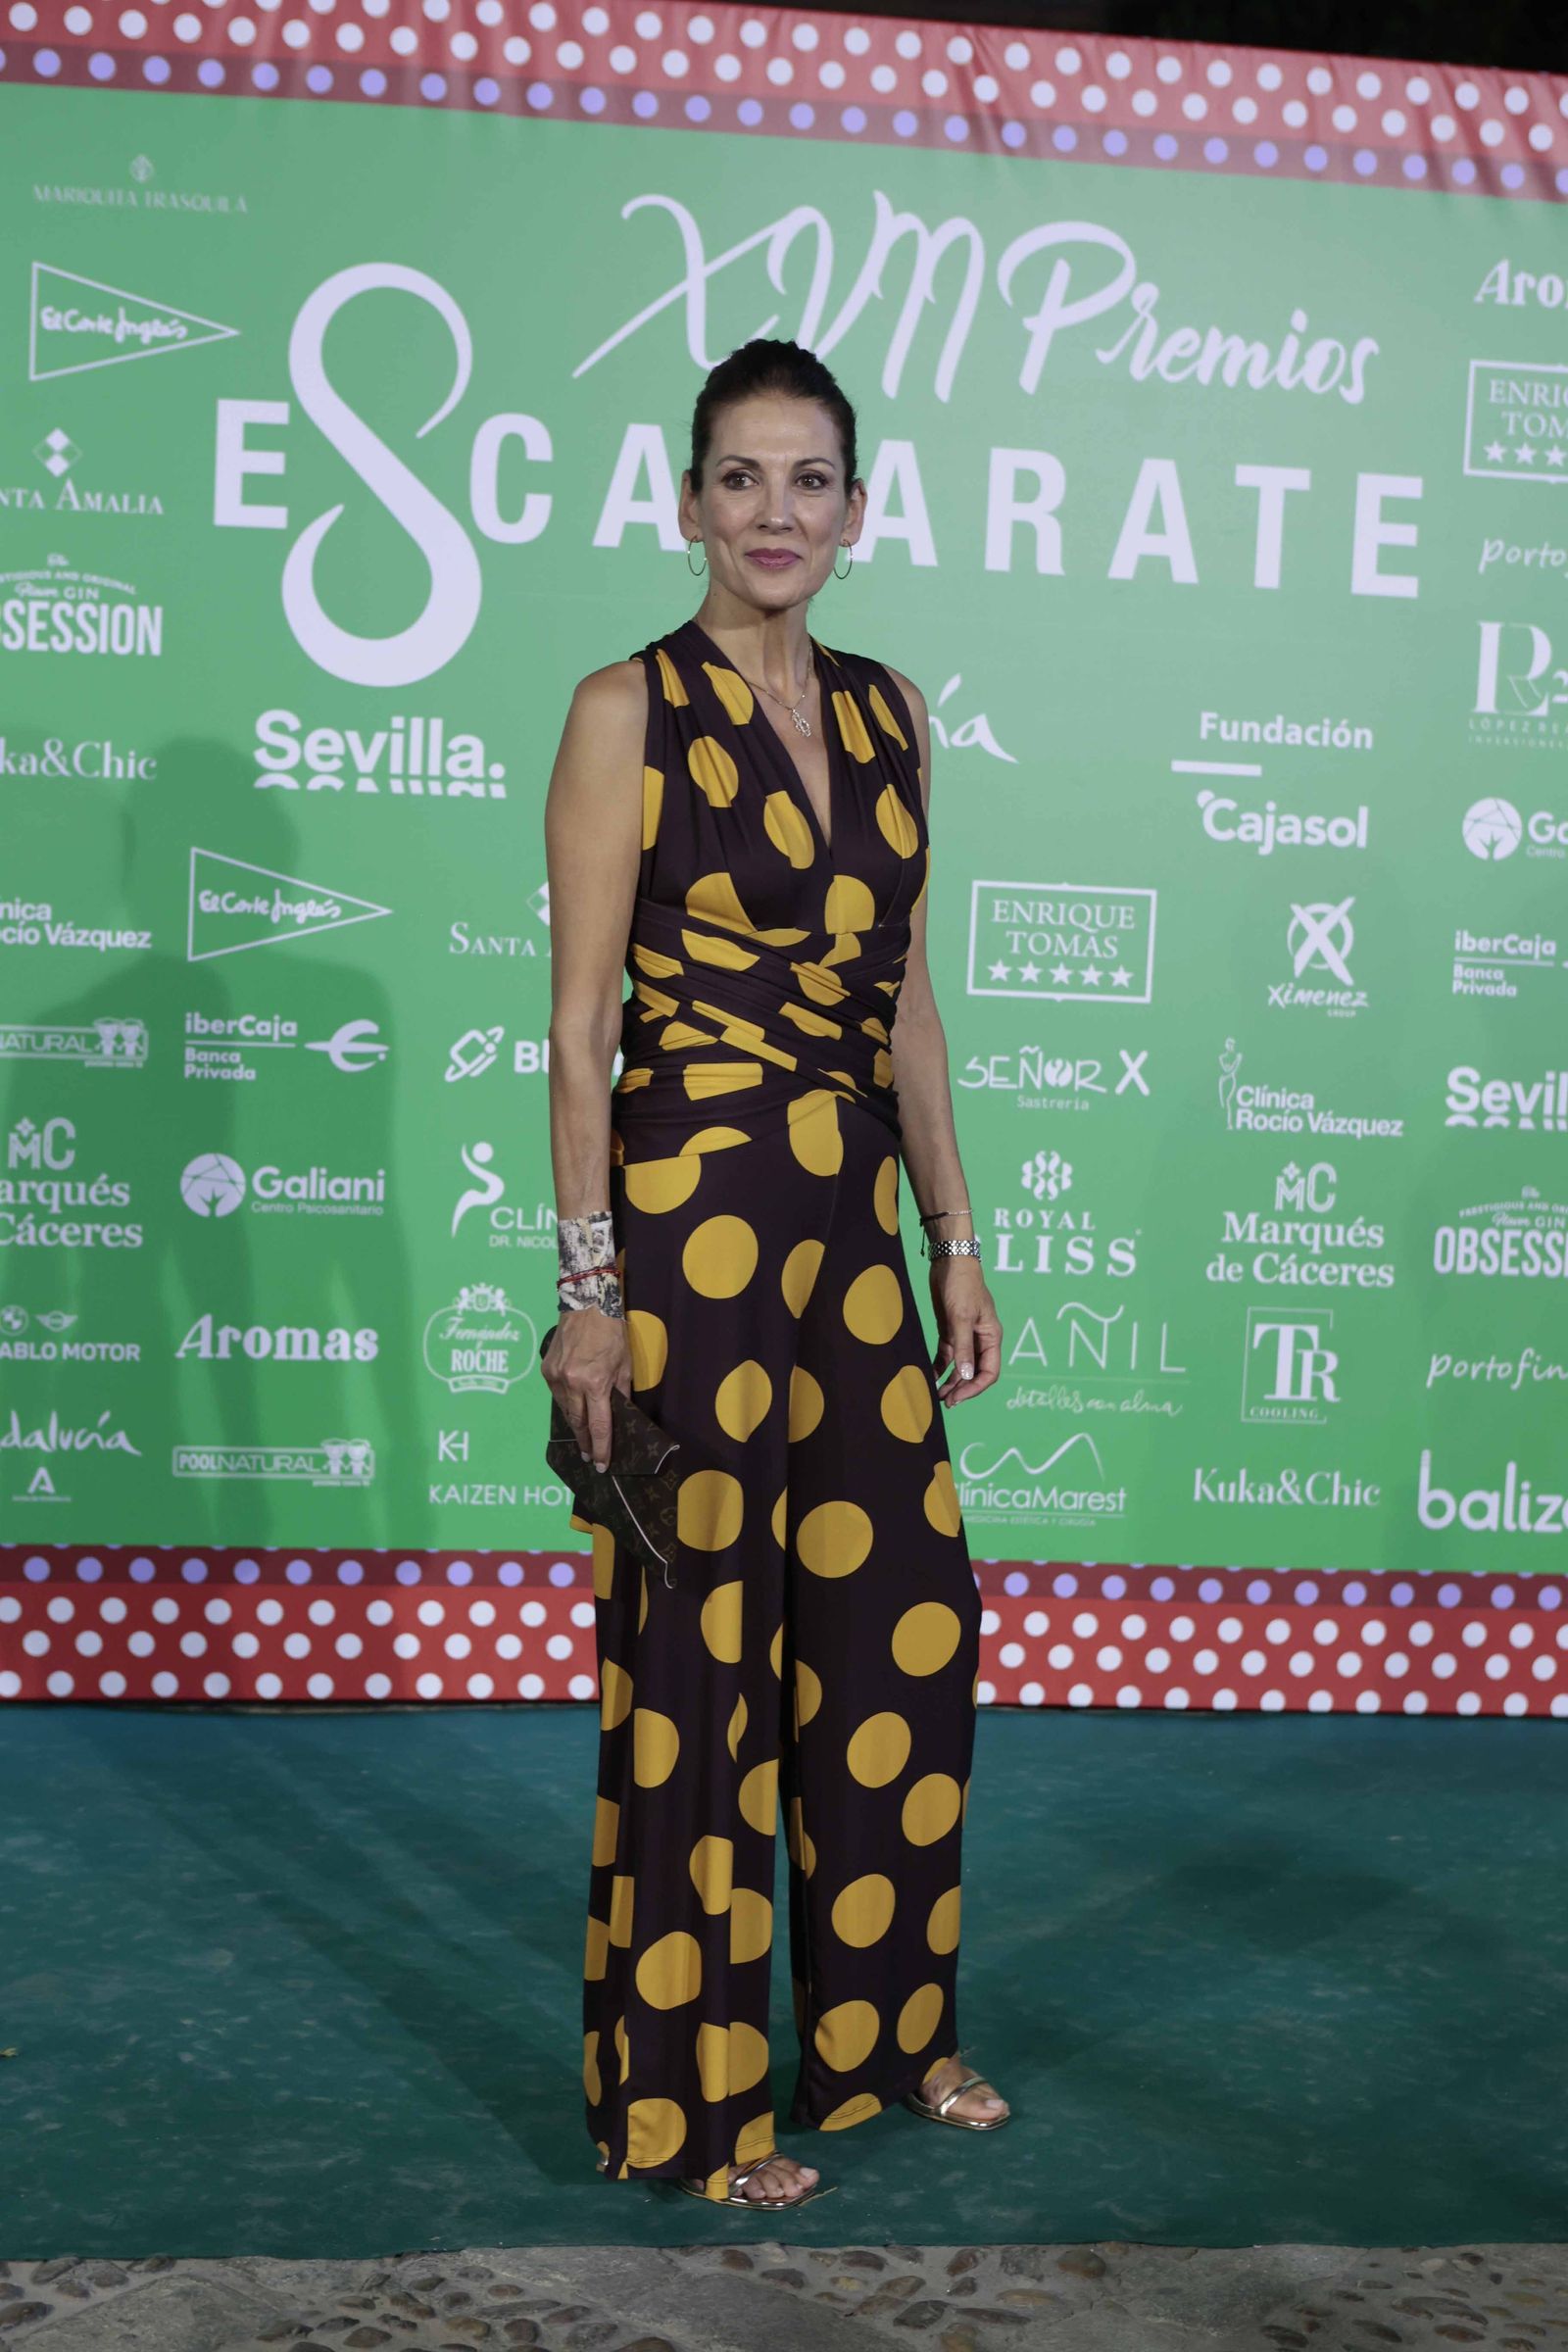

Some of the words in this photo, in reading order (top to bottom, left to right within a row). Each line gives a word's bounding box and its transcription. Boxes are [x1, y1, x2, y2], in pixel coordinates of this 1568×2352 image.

[1473, 258, 1568, 309] Aro
[41, 306, 63, 331] El
[64, 309, 114, 334] Corte
[996, 220, 1380, 405] Premios
[1489, 378, 1568, 409] ENRI
[1478, 537, 1568, 576] porto
[64, 586, 99, 600] GIN
[0, 599, 164, 657] SESSION
[1200, 710, 1373, 750] Fundación
[1200, 796, 1369, 857] Cajasol
[1526, 844, 1566, 860] Centro
[0, 897, 53, 921] nica
[198, 889, 220, 913] El
[220, 891, 270, 916] Corte
[270, 887, 342, 924] Inglés
[991, 899, 1136, 934] ENRIQUE
[0, 920, 41, 946] cío
[45, 921, 153, 953] Vázquez
[449, 921, 537, 957] SANTA
[1454, 929, 1557, 960] iberCaja
[1452, 962, 1504, 980] Banca
[1451, 980, 1518, 998] Privada
[184, 1011, 298, 1043] iberCaja
[184, 1047, 241, 1064] Banca
[956, 1045, 1107, 1093] SEÑOR
[1114, 1049, 1151, 1097] X
[183, 1063, 257, 1081] Privada
[1236, 1085, 1315, 1110] Clínica
[1235, 1108, 1303, 1133] Rocío
[1306, 1110, 1404, 1140] Vázquez
[251, 1165, 386, 1202] Galiani
[251, 1200, 294, 1214] Centro
[297, 1201, 384, 1216] Psicosanitario
[992, 1206, 1097, 1231] ROYAL
[1534, 1215, 1567, 1229] GIN
[489, 1235, 513, 1249] DR.
[1221, 1210, 1385, 1255] Marqués
[992, 1233, 1137, 1278] LISS
[1205, 1253, 1244, 1283] de
[1252, 1251, 1396, 1288] Cáceres
[174, 1312, 379, 1362] Aromas
[438, 1316, 522, 1344] Fernández
[1007, 1300, 1187, 1374] AÑIL
[62, 1343, 141, 1362] MOTOR
[450, 1348, 510, 1373] ROCHE
[1252, 1322, 1342, 1403] TR
[1004, 1384, 1084, 1414] detalles
[1119, 1389, 1184, 1417] alma
[1250, 1406, 1319, 1420] COOLING
[178, 1452, 322, 1474] POOLNATURAL
[427, 1484, 517, 1506] KAIZEN
[956, 1481, 1127, 1512] línicaMarest
[1192, 1466, 1382, 1507] Kuka&Chic
